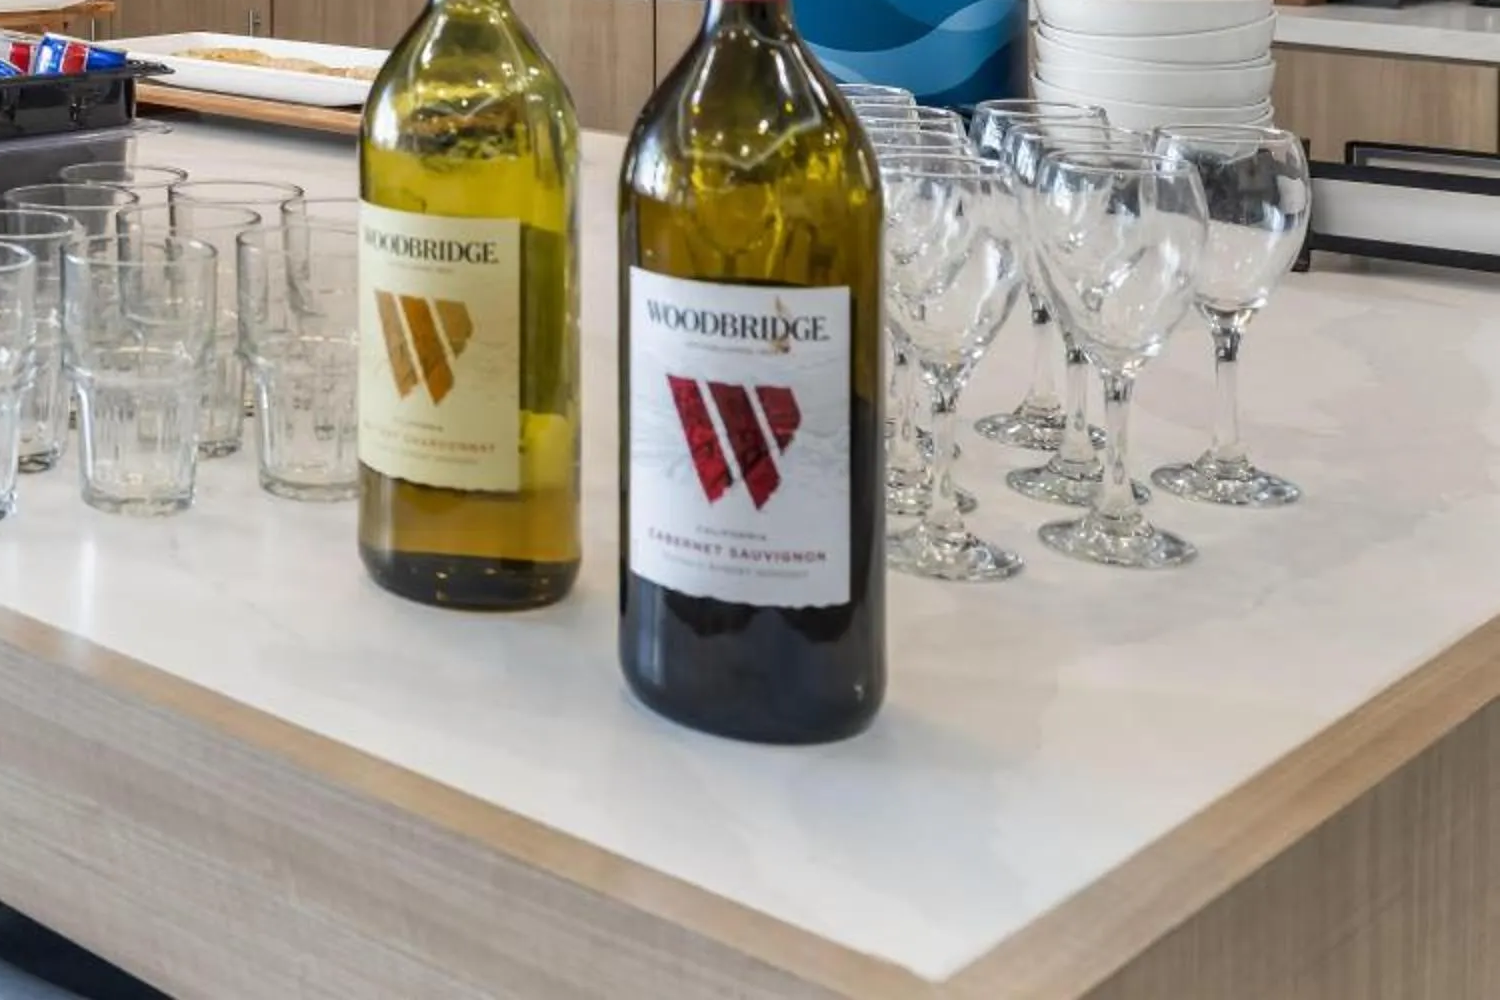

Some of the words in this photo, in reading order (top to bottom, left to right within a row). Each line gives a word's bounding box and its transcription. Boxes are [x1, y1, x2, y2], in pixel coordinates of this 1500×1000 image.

[647, 299, 830, 342] WOODBRIDGE
[648, 527, 723, 557] CABERNET
[729, 547, 827, 564] SAUVIGNON
